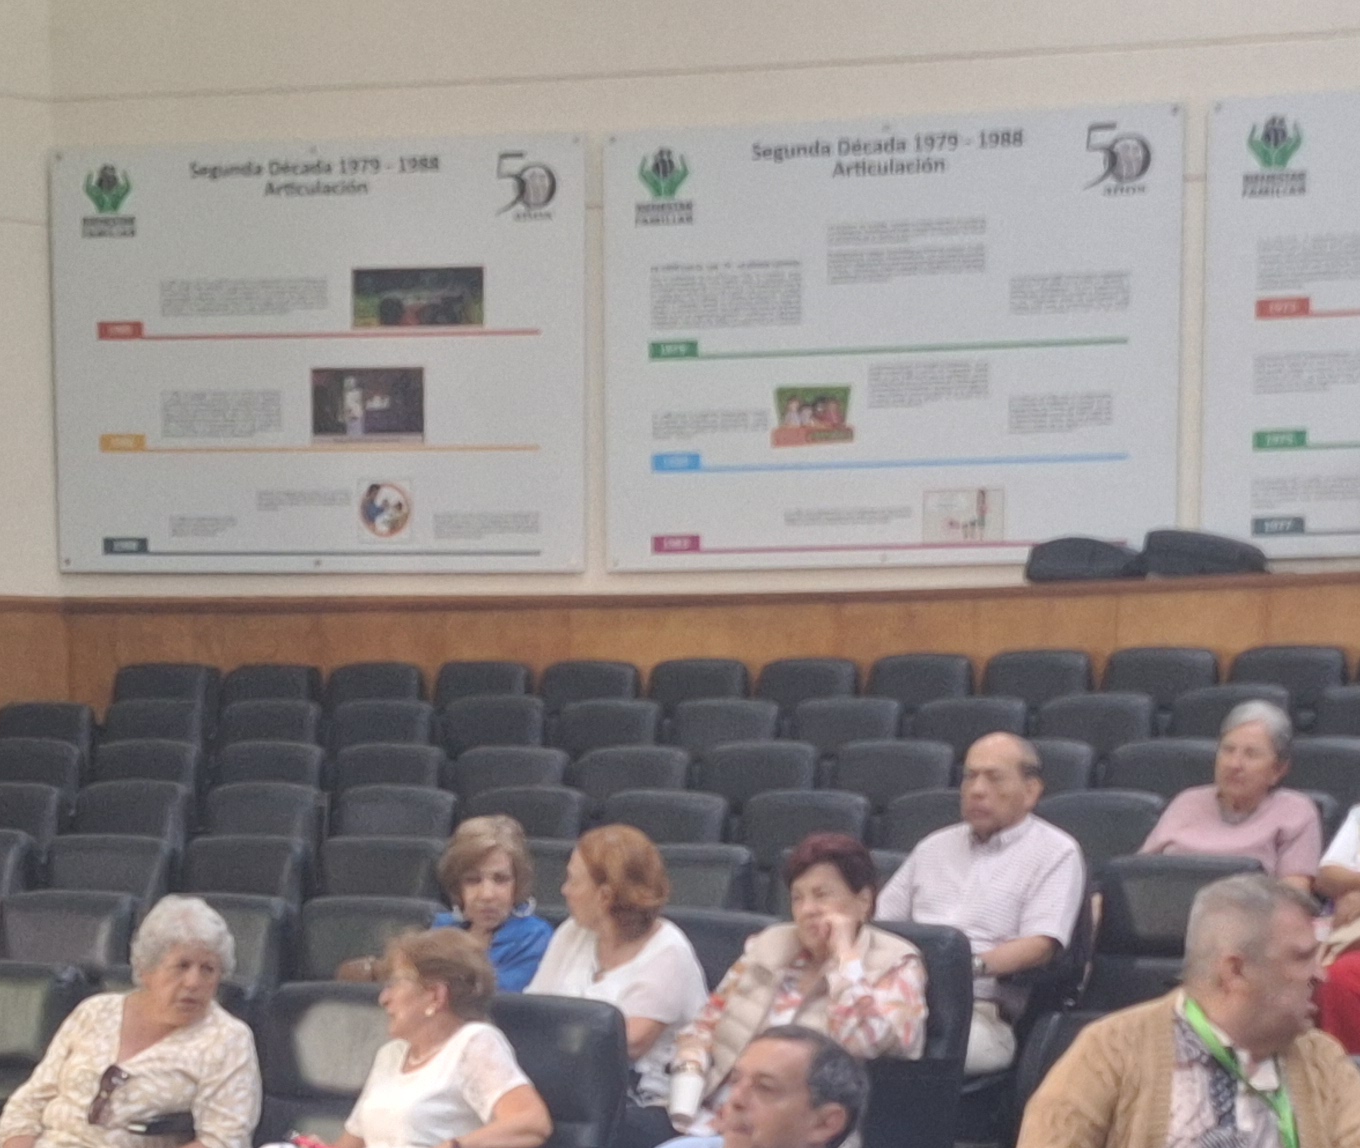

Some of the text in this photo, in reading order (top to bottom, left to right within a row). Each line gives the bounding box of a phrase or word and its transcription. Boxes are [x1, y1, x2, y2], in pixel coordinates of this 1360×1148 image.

[751, 140, 832, 164] Segunda
[836, 136, 906, 158] Década
[831, 157, 946, 179] Articulación
